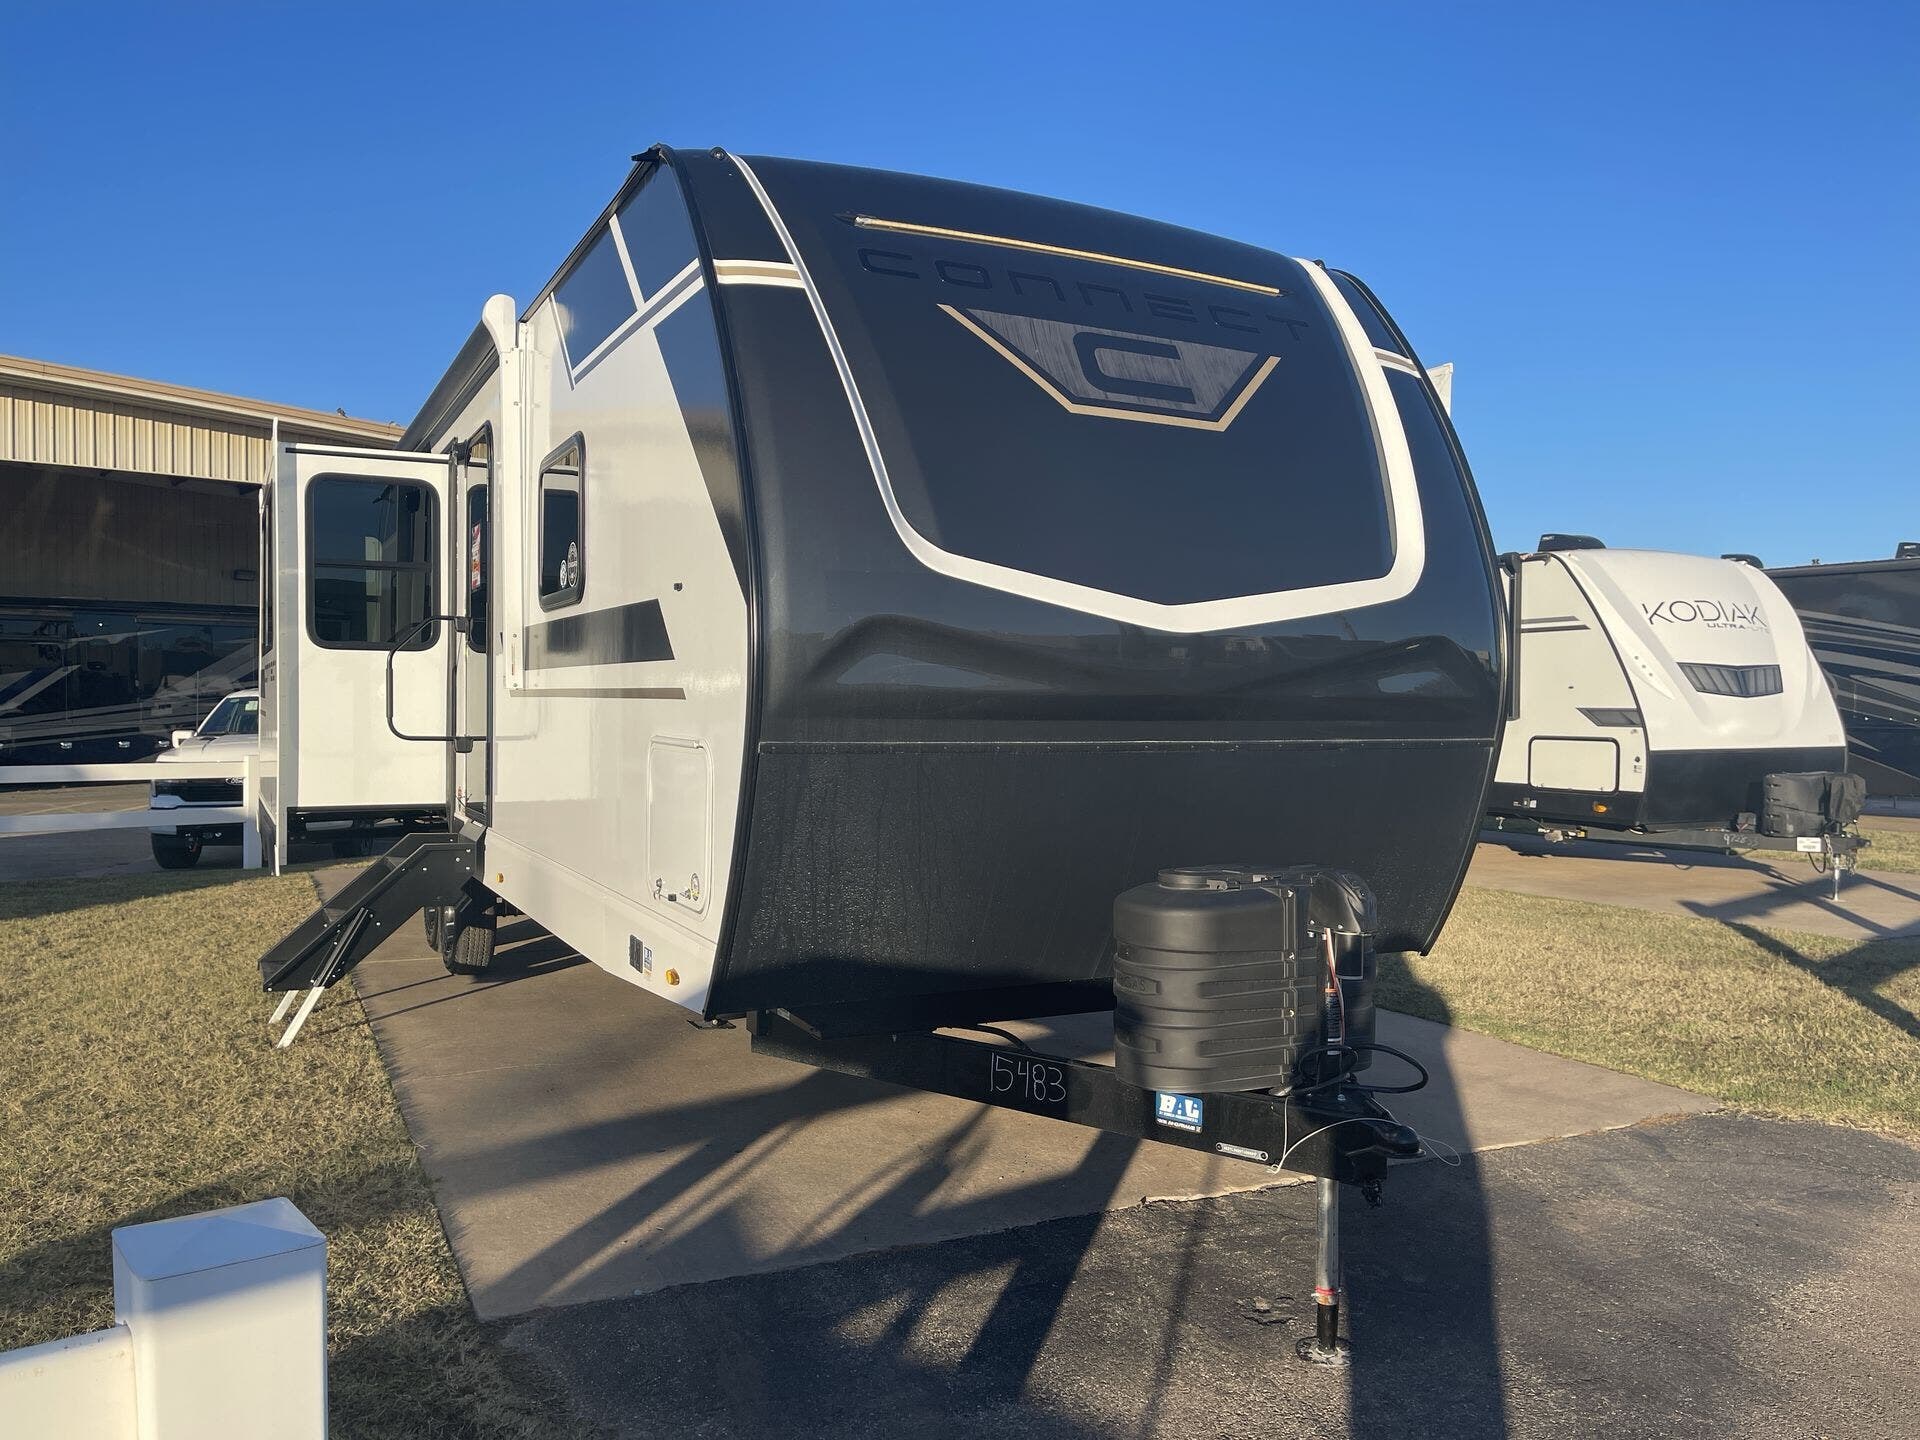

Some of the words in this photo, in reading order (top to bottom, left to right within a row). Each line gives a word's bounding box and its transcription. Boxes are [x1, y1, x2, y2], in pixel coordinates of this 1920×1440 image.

[857, 247, 1309, 340] CONNECT
[1642, 600, 1768, 627] KODIAK
[989, 1052, 1067, 1102] 15483
